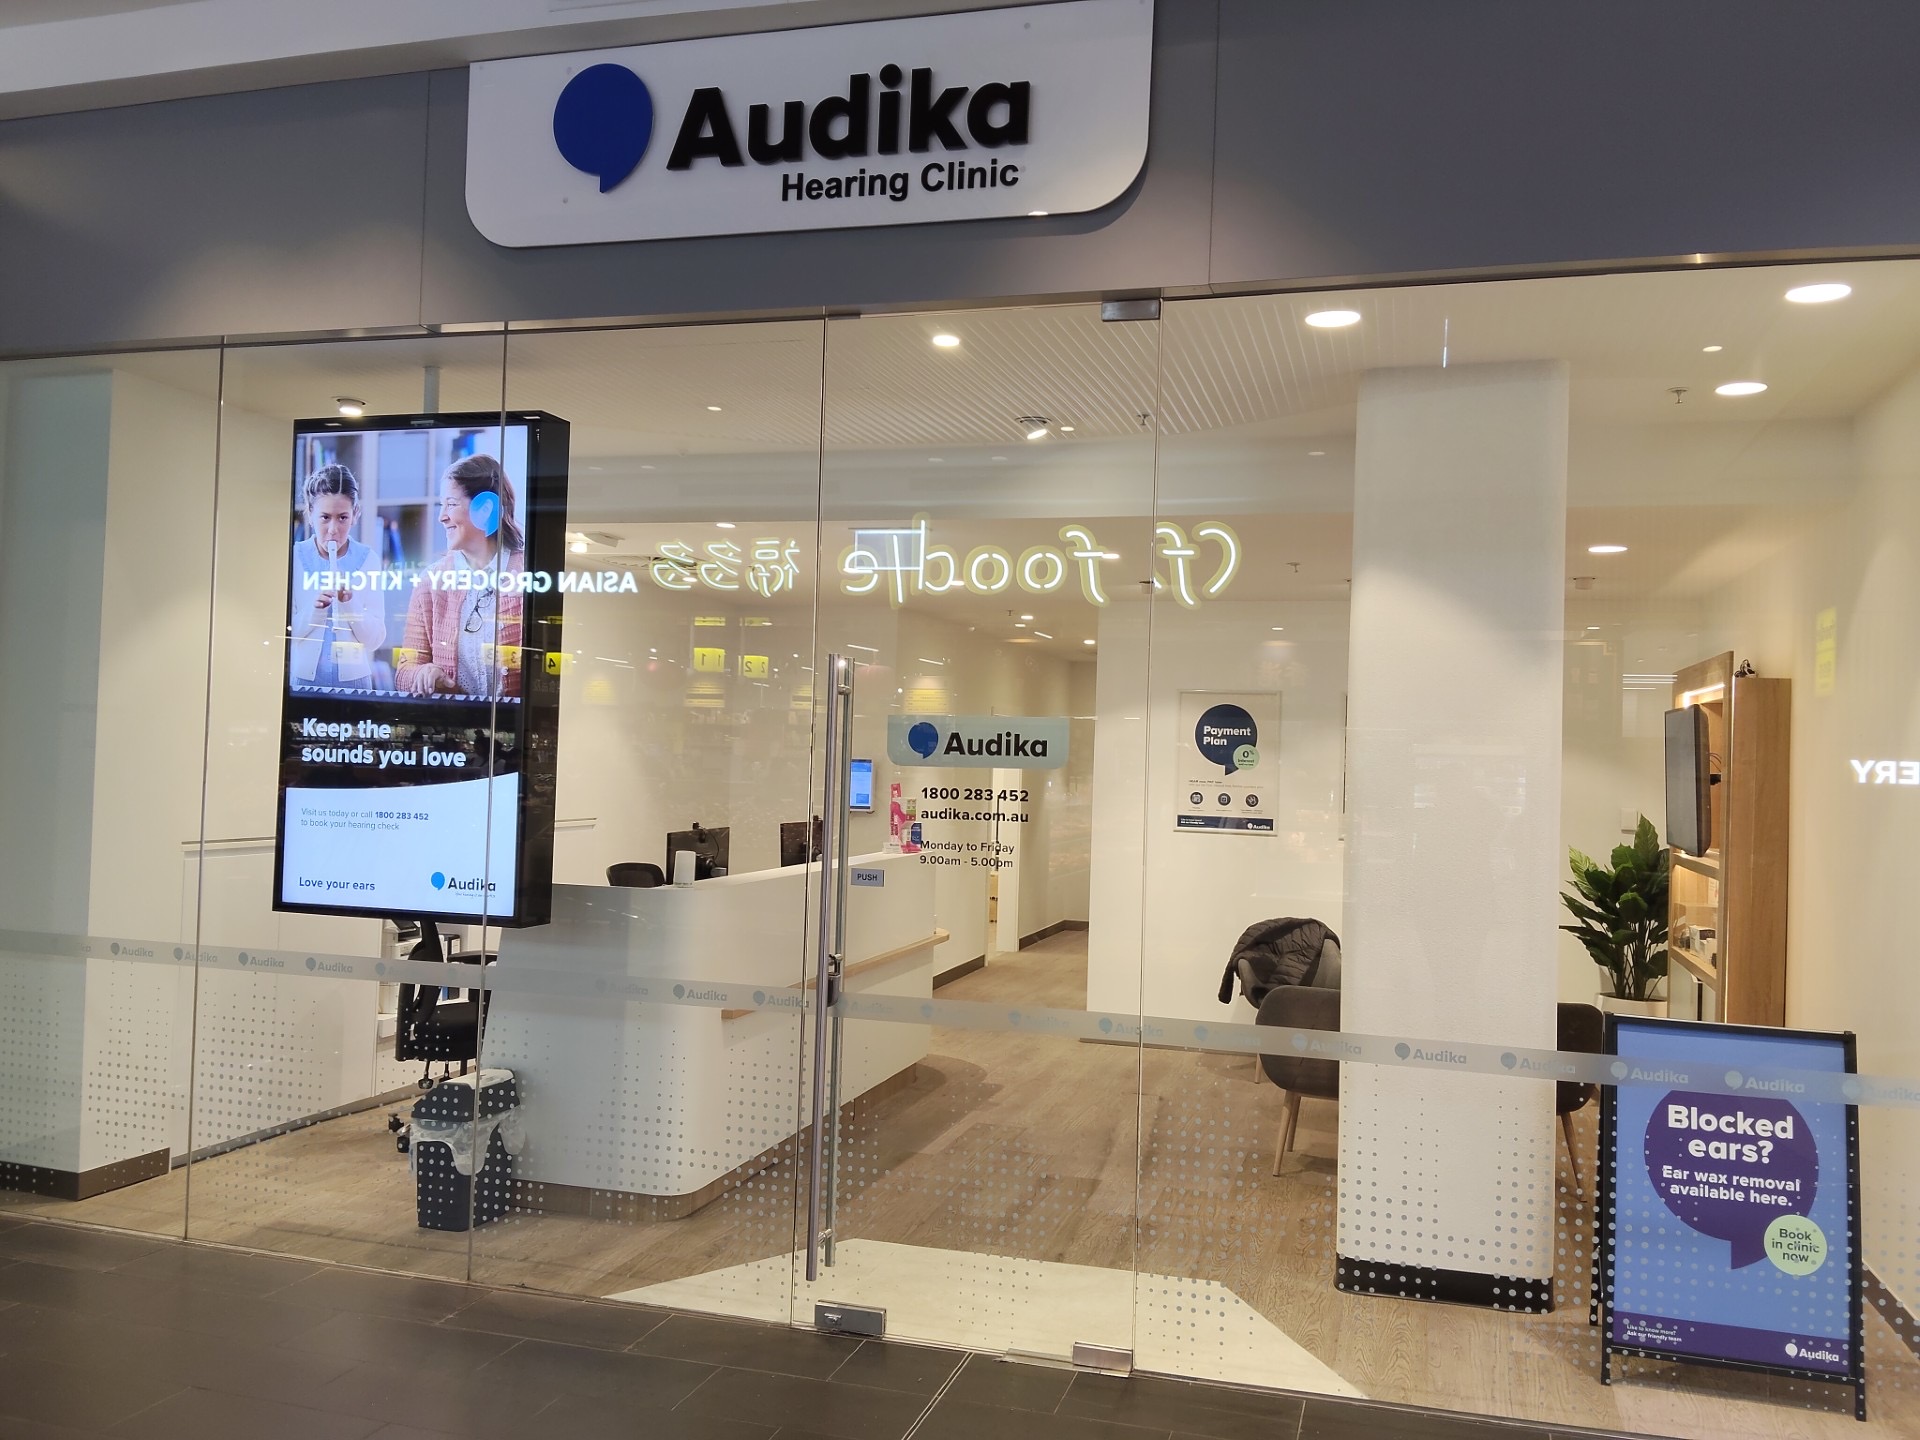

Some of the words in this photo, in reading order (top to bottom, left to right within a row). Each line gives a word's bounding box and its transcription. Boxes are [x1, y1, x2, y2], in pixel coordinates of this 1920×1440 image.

[666, 63, 1031, 171] Audika
[781, 167, 909, 201] Hearing
[920, 158, 1020, 192] Clinic
[302, 718, 352, 741] Keep
[358, 720, 391, 739] the
[1203, 725, 1252, 738] Payment
[943, 731, 1048, 758] Audika
[1203, 737, 1228, 746] Plan
[301, 745, 374, 764] sounds
[378, 748, 417, 769] you
[422, 747, 466, 767] love
[921, 786, 960, 800] 1800
[964, 788, 993, 801] 283
[998, 789, 1029, 802] 452
[301, 807, 317, 816] Visit
[328, 809, 349, 819] today
[360, 810, 373, 818] call
[375, 811, 394, 819] 1800
[396, 812, 412, 820] 283
[413, 812, 429, 821] 452
[921, 808, 1029, 822] audika.com.au
[301, 819, 308, 827] to
[309, 819, 328, 827] book
[329, 821, 346, 830] your
[347, 820, 376, 831] hearing
[377, 822, 400, 830] check
[920, 841, 962, 853] Monday
[966, 842, 977, 852] to
[980, 842, 1014, 854] Friday
[919, 855, 961, 866] 9.00am
[970, 857, 1013, 870] 5.00pm
[299, 876, 323, 888] Love
[326, 880, 350, 891] your
[352, 882, 376, 891] ears
[857, 873, 878, 882] PUSH
[121, 947, 154, 958] Audika
[250, 956, 285, 968] Audika
[317, 961, 353, 974] Audika
[686, 989, 728, 1002] Audika
[1413, 1048, 1467, 1065] Audika
[1630, 1067, 1689, 1085] Audika
[1745, 1076, 1805, 1094] Audika
[1667, 1104, 1794, 1140] Blocked
[1688, 1138, 1774, 1164] ears?
[1662, 1165, 1690, 1180] Ear
[1694, 1171, 1728, 1185] wax
[1732, 1174, 1801, 1192] removal
[1670, 1184, 1745, 1202] available
[1750, 1190, 1793, 1206] here.
[1779, 1228, 1812, 1241] Book
[1771, 1238, 1783, 1249] in
[1787, 1241, 1820, 1254] clinic
[1782, 1251, 1809, 1263] now
[1647, 1333, 1668, 1341] friendly
[1799, 1348, 1840, 1362] Audika
